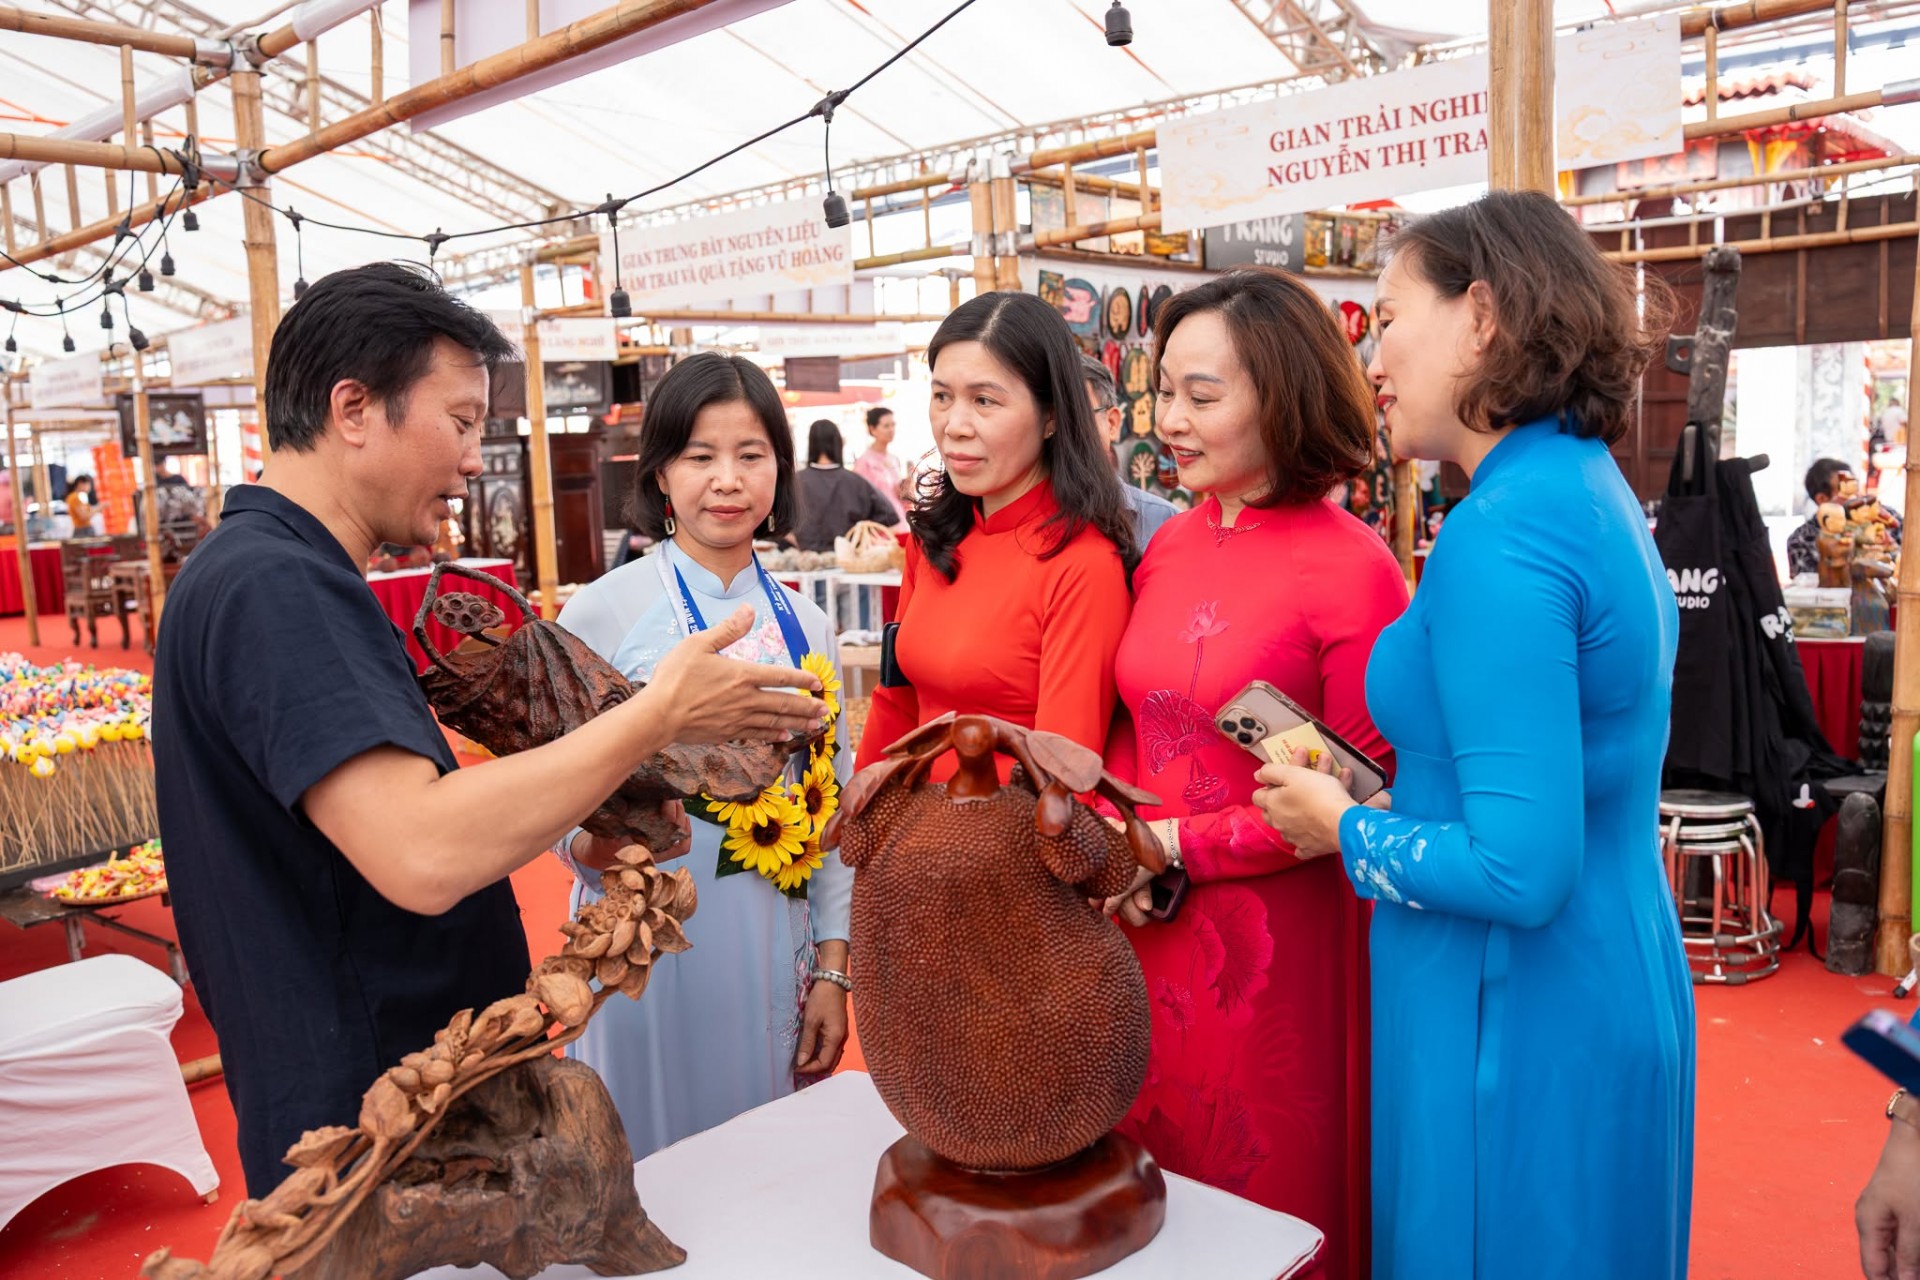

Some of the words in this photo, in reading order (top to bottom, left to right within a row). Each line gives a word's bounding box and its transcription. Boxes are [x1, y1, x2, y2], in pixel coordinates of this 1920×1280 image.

[1269, 121, 1331, 154] GIAN
[1337, 104, 1402, 141] TRẢI
[1267, 144, 1370, 188] NGUYỄN
[1377, 138, 1427, 168] THỊ
[1433, 128, 1488, 158] TRA
[622, 250, 652, 270] GIAN
[700, 235, 724, 257] BÀY
[728, 226, 784, 252] NGUYÊN
[788, 219, 821, 244] LIỆU
[649, 270, 679, 290] TRAI
[681, 264, 697, 283] VÀ
[699, 259, 726, 285] QUÀ
[729, 256, 765, 280] TẶNG
[768, 249, 787, 270] VŨ
[791, 244, 843, 268] HOÀNG
[1666, 567, 1719, 594] ANG
[1677, 596, 1710, 609] UDIO
[1760, 605, 1792, 640] RA
